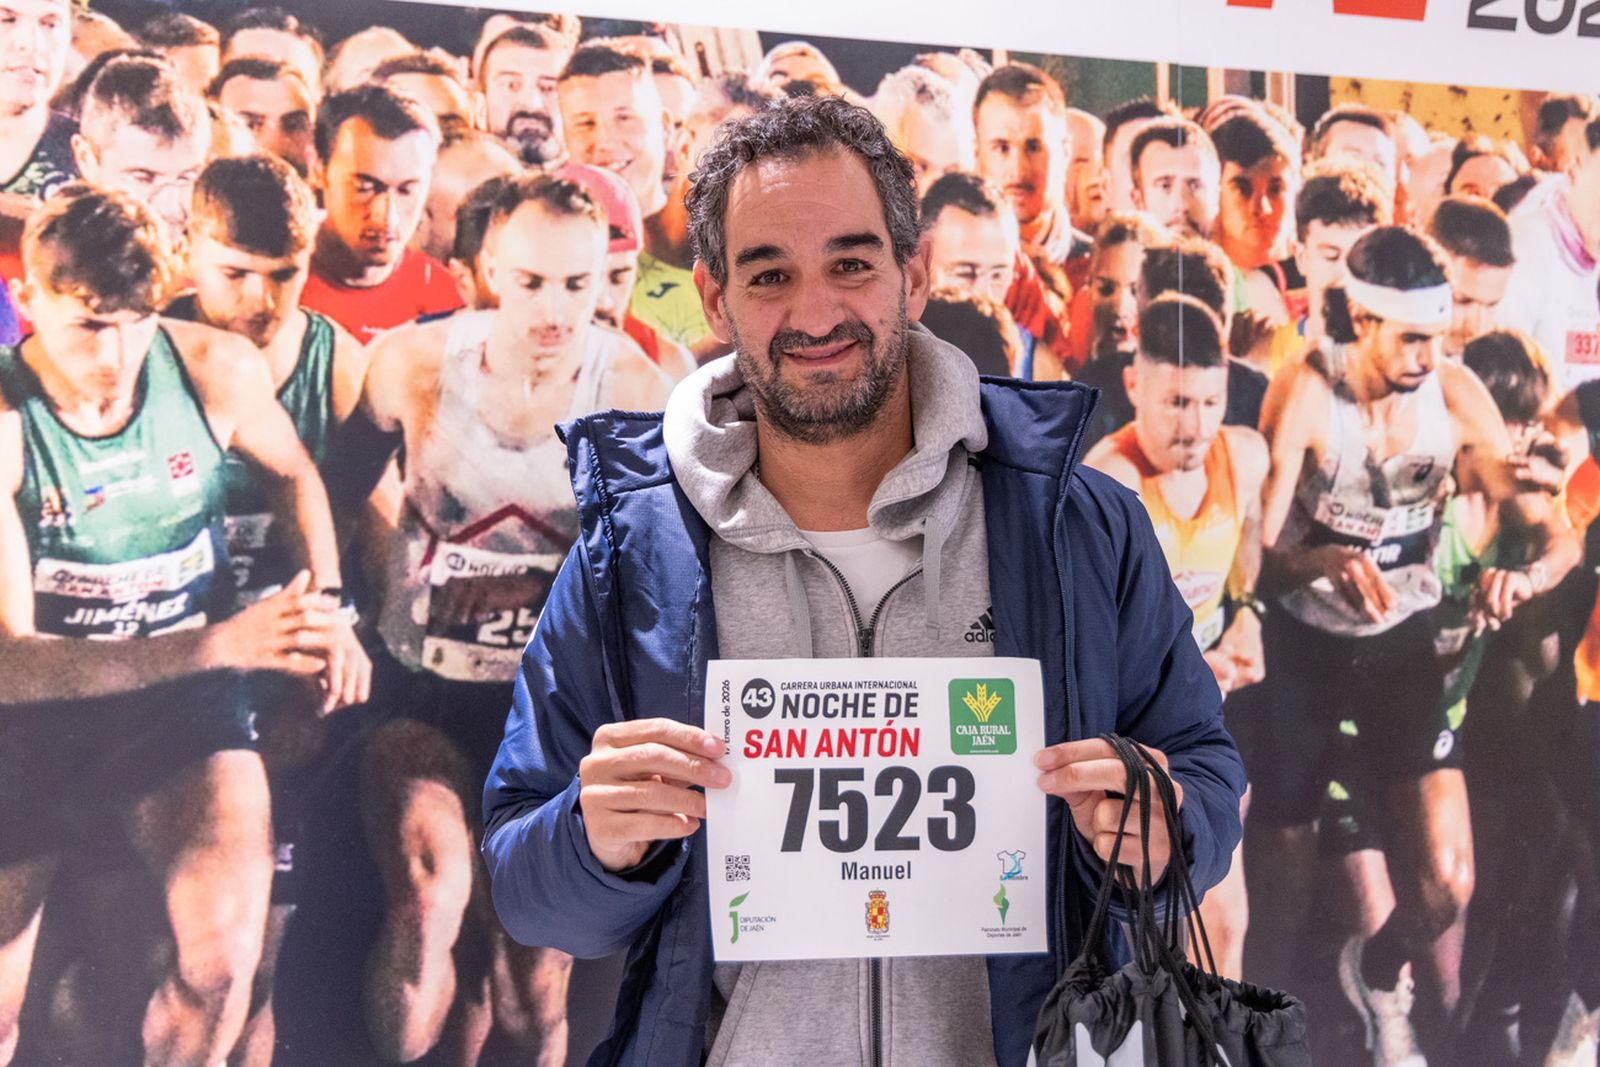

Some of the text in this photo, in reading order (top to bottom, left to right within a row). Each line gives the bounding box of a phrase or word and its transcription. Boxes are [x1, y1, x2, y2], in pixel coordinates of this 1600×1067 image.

[63, 591, 189, 625] JIMÉNEZ
[722, 679, 730, 703] 2026
[781, 680, 918, 691] CARRERA URBANA INTERNACIONAL
[742, 687, 773, 708] 43
[781, 692, 919, 719] NOCHE DE
[722, 705, 730, 717] de
[743, 720, 920, 758] SAN ANTÓN
[955, 725, 1011, 735] CAJA RURAL
[972, 734, 996, 746] JAÉN
[774, 765, 976, 853] 7523
[841, 861, 912, 880] Manuel
